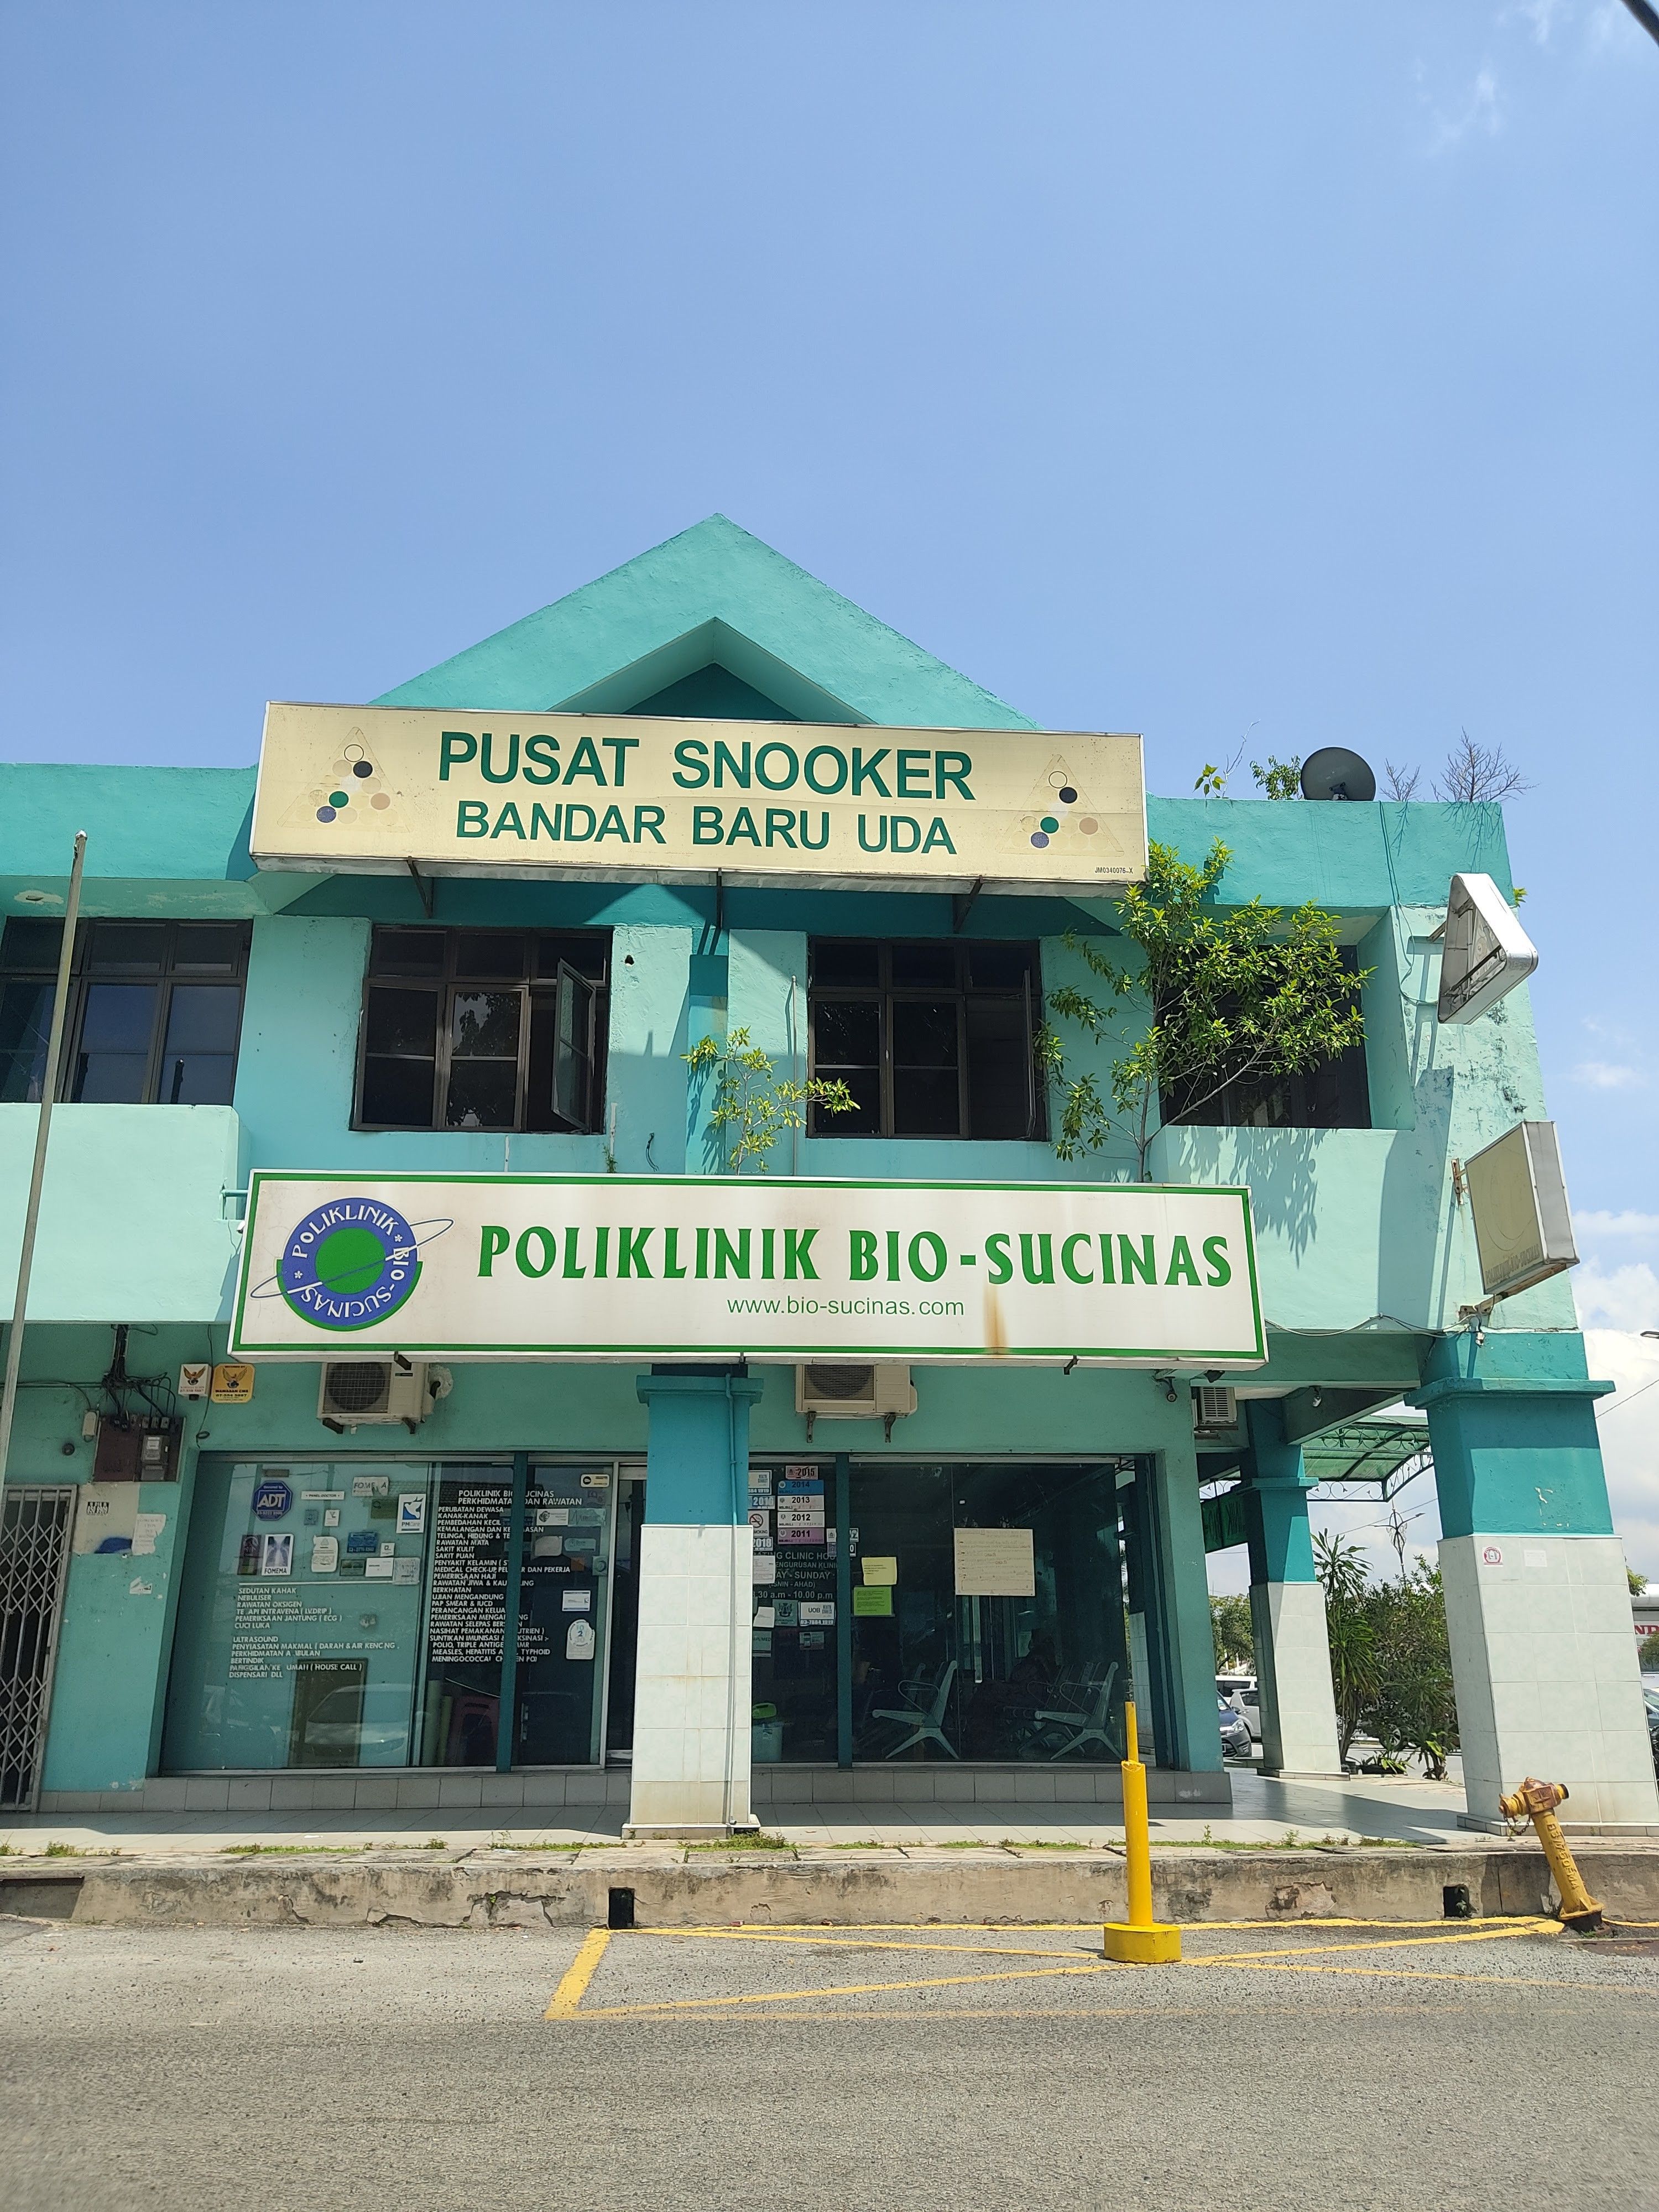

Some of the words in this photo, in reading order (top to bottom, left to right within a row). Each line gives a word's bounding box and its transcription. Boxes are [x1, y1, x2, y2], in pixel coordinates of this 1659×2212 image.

[439, 732, 639, 788] PUSAT
[672, 739, 973, 800] SNOOKER
[458, 800, 666, 843] BANDAR
[695, 806, 830, 851] BARU
[859, 815, 958, 854] UDA
[292, 1204, 399, 1259] POLIKLINIK
[477, 1225, 822, 1280] POLIKLINIK
[849, 1229, 1233, 1287] BIO-SUCINAS
[300, 1246, 411, 1319] BIO-SUCINAS
[728, 1296, 964, 1316] www.bio-sucinas.com
[797, 1468, 815, 1477] 2015
[257, 1493, 286, 1507] ADT
[795, 1571, 830, 1579] SUNDAY
[817, 1592, 833, 1600] p.m
